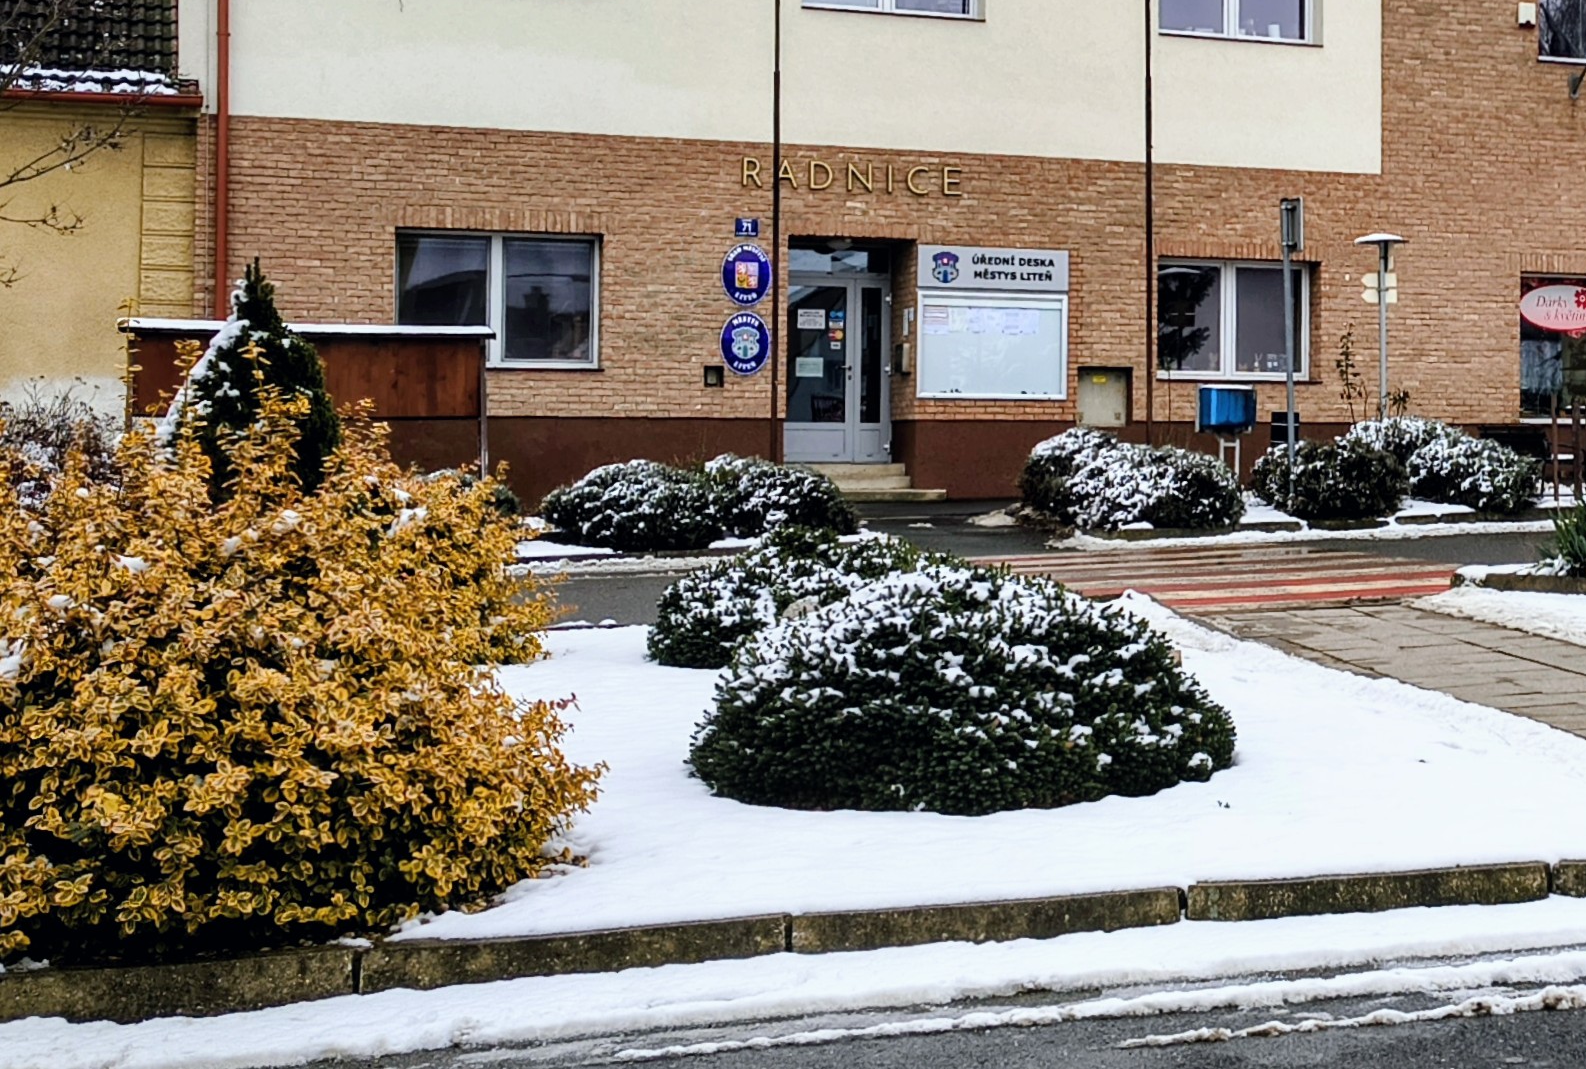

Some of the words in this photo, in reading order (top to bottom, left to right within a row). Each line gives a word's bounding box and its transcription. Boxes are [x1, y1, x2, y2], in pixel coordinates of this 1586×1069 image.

[741, 157, 963, 196] RADNICE
[741, 222, 752, 232] 71
[972, 253, 1015, 266] ÚŘEDNÍ
[1018, 257, 1055, 268] DESKA
[974, 268, 1017, 281] MĚSTYS
[1020, 270, 1053, 282] LITEŇ
[1536, 295, 1568, 308] Dárky
